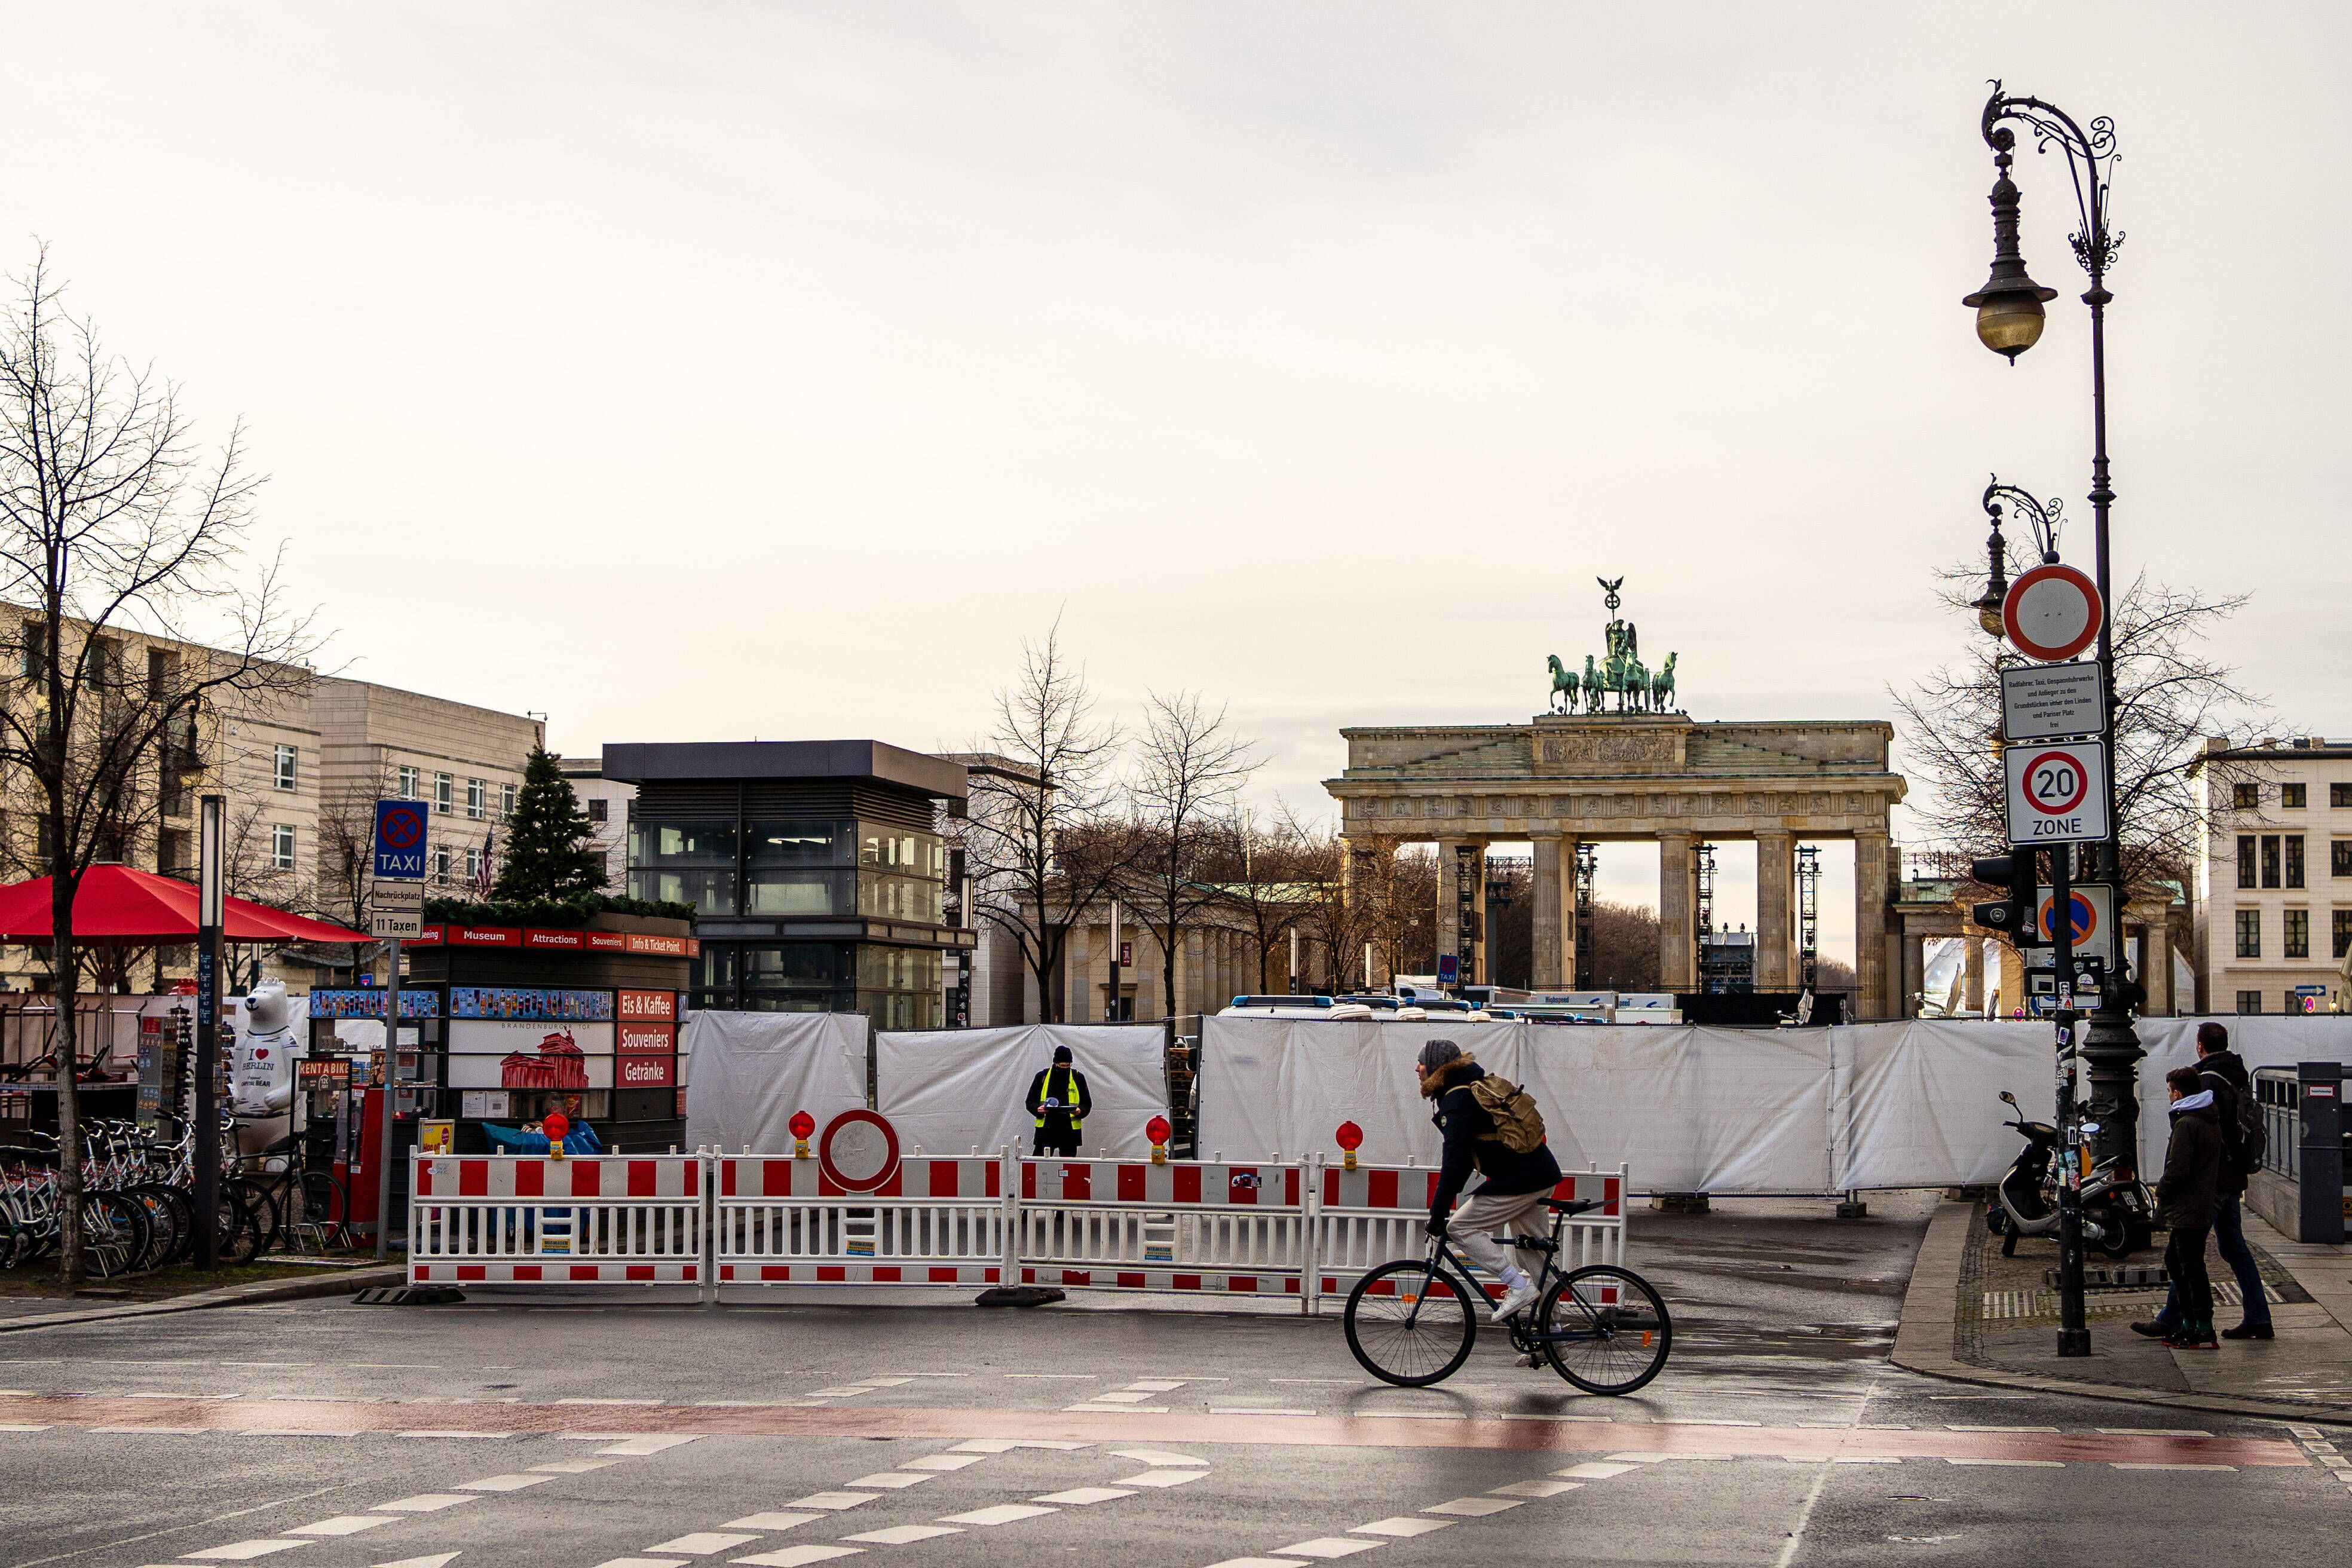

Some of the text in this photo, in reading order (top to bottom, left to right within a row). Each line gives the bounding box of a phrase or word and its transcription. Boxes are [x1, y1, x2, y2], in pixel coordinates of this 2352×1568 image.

[2014, 701, 2048, 709] Grundstücken
[2037, 768, 2074, 798] 20
[2032, 818, 2082, 835] ZONE
[379, 854, 421, 871] TAXI
[375, 890, 421, 901] Nachrückplatz
[376, 918, 417, 932] 11 Taxen
[464, 930, 505, 941] Museum
[532, 934, 578, 944] Attractions
[592, 936, 622, 947] Souveniers
[632, 938, 644, 950] Info
[644, 939, 649, 950] &
[650, 939, 666, 951] Ticket
[666, 941, 680, 953] Point
[622, 995, 670, 1015] Eis & Kaffee
[1545, 996, 1569, 1004] Highspeed
[622, 1028, 669, 1048] Souveniers
[248, 1048, 255, 1061] I
[242, 1062, 274, 1071] BERLIN
[299, 1062, 350, 1074] RENT A BIKE
[625, 1061, 664, 1081] Getränke
